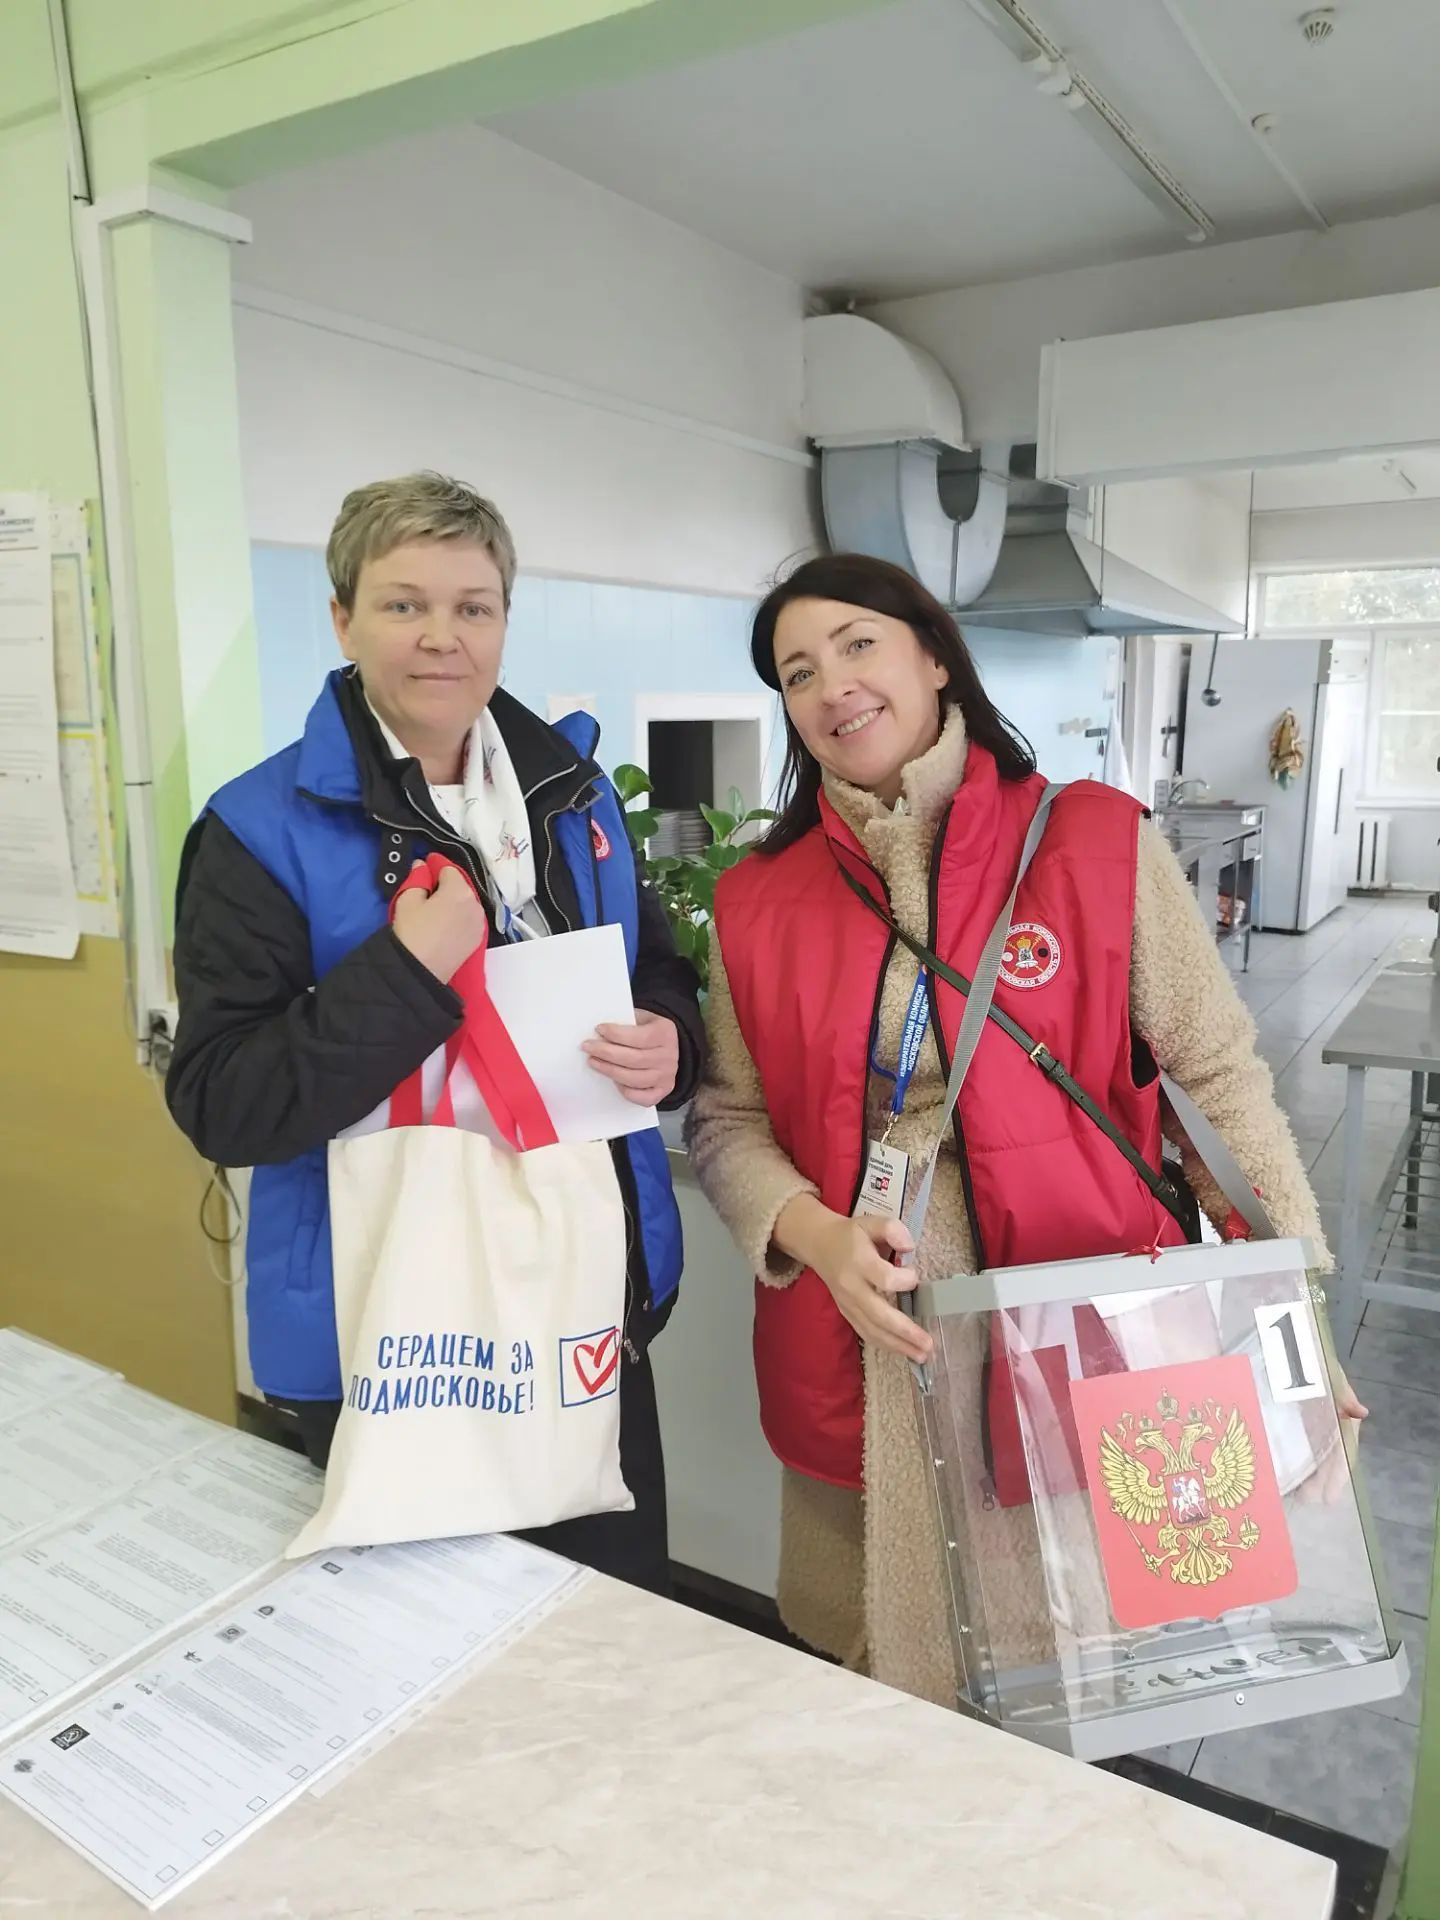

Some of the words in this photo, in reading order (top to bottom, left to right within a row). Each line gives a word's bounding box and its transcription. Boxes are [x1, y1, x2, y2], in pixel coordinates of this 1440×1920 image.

[900, 1020, 916, 1078] ИЗБИРАТЕЛЬНАЯ
[909, 984, 926, 1021] КОМИССИЯ
[907, 1024, 925, 1071] МОСКОВСКОЙ
[378, 1333, 494, 1371] СЕРДЦЕМ
[511, 1340, 534, 1374] ЗА
[1269, 1311, 1316, 1390] 1
[348, 1374, 534, 1415] ПОДМОСКОВЬЕ!
